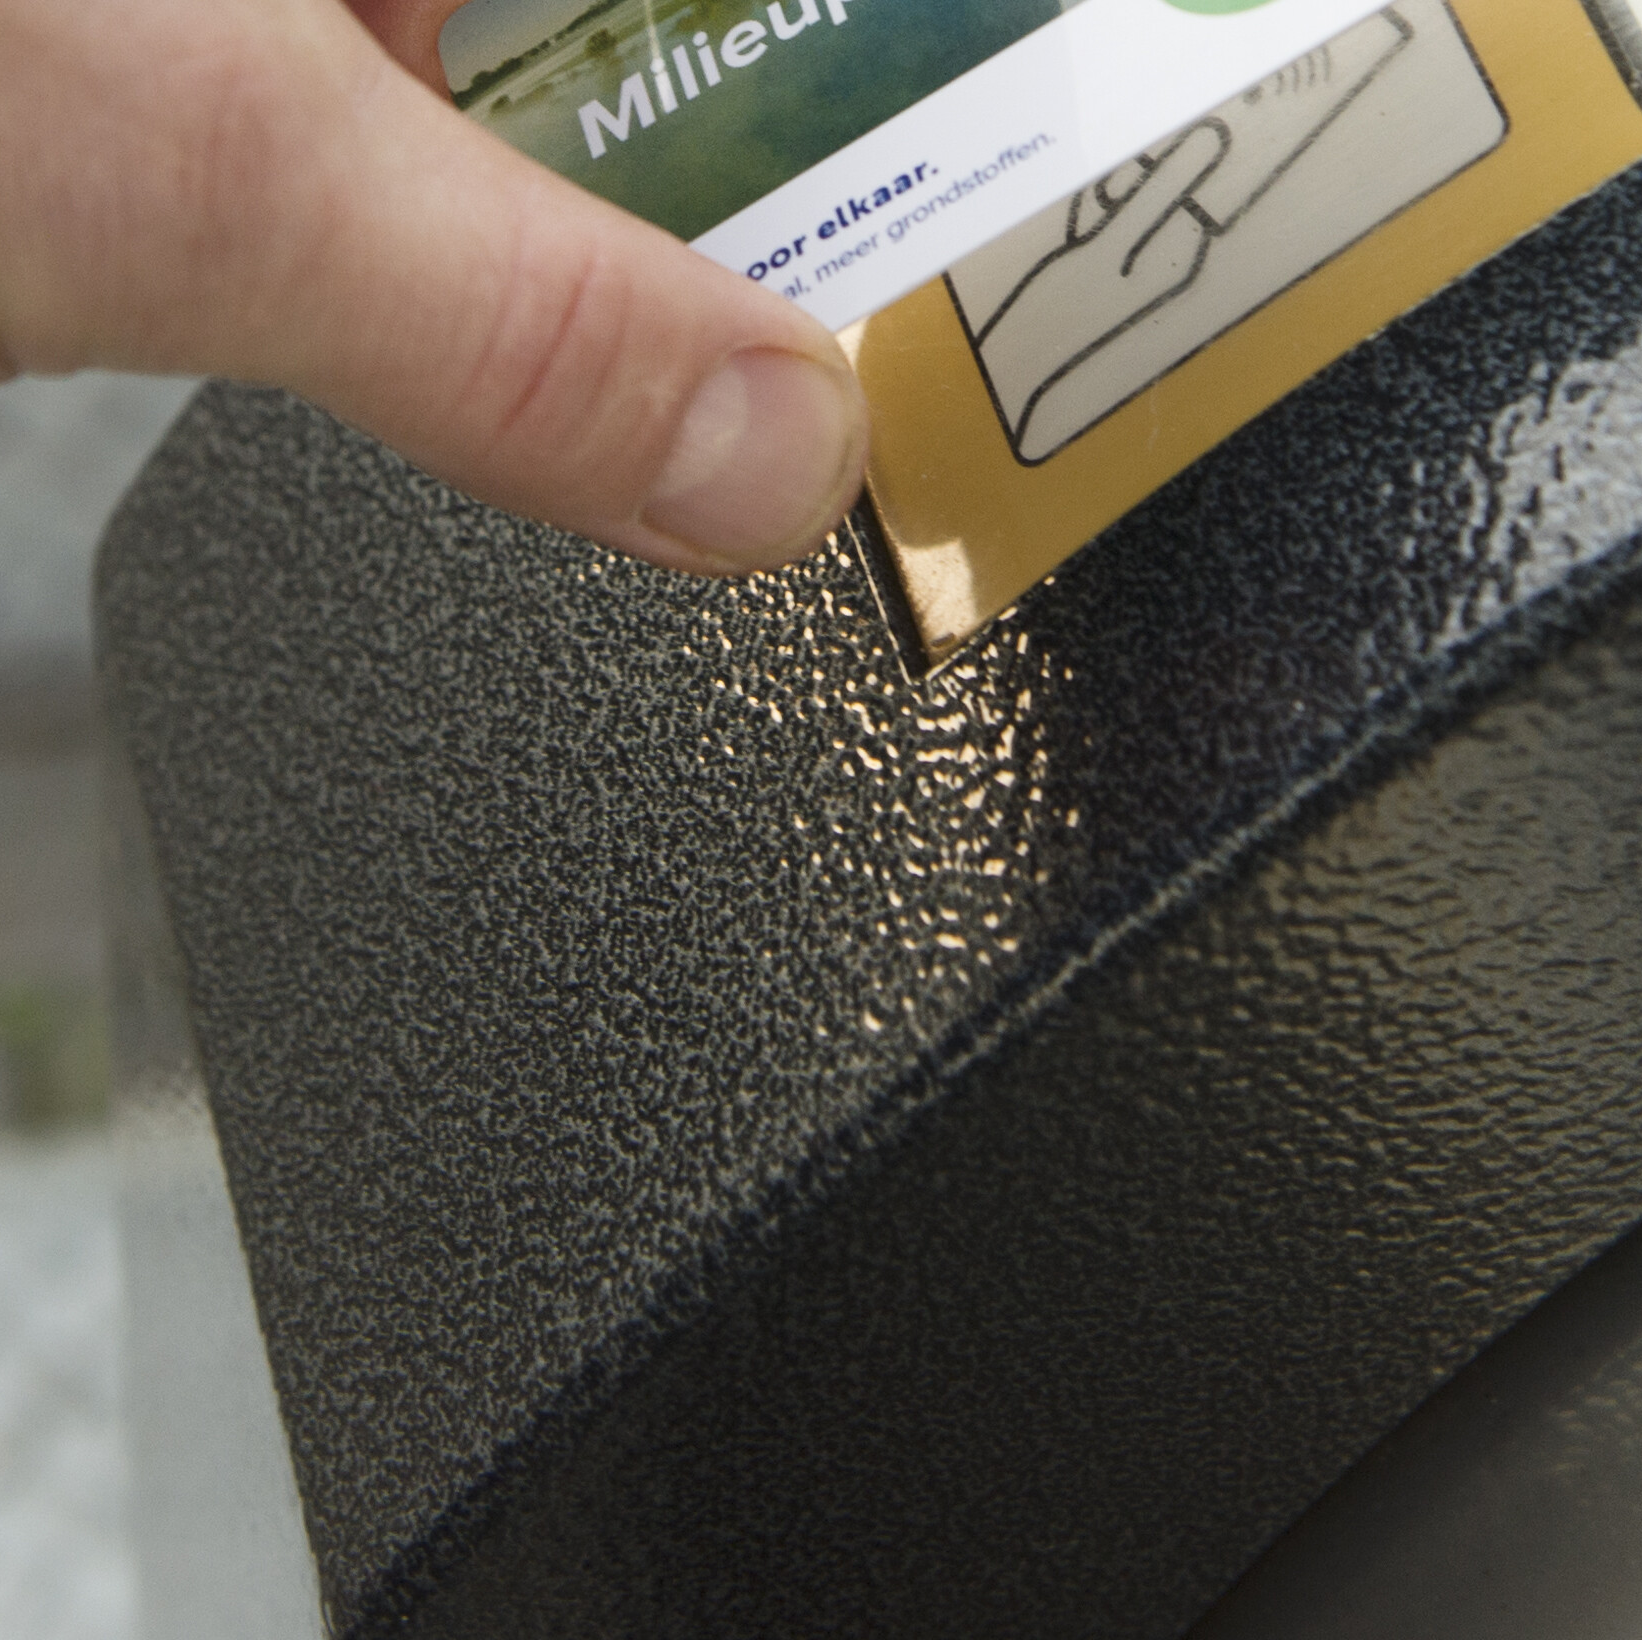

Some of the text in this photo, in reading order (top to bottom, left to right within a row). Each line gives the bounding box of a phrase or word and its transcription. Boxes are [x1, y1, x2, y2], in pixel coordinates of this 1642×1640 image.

[744, 160, 939, 282] oor elkaar.
[781, 130, 1057, 301] al, meer grondstoffen.
